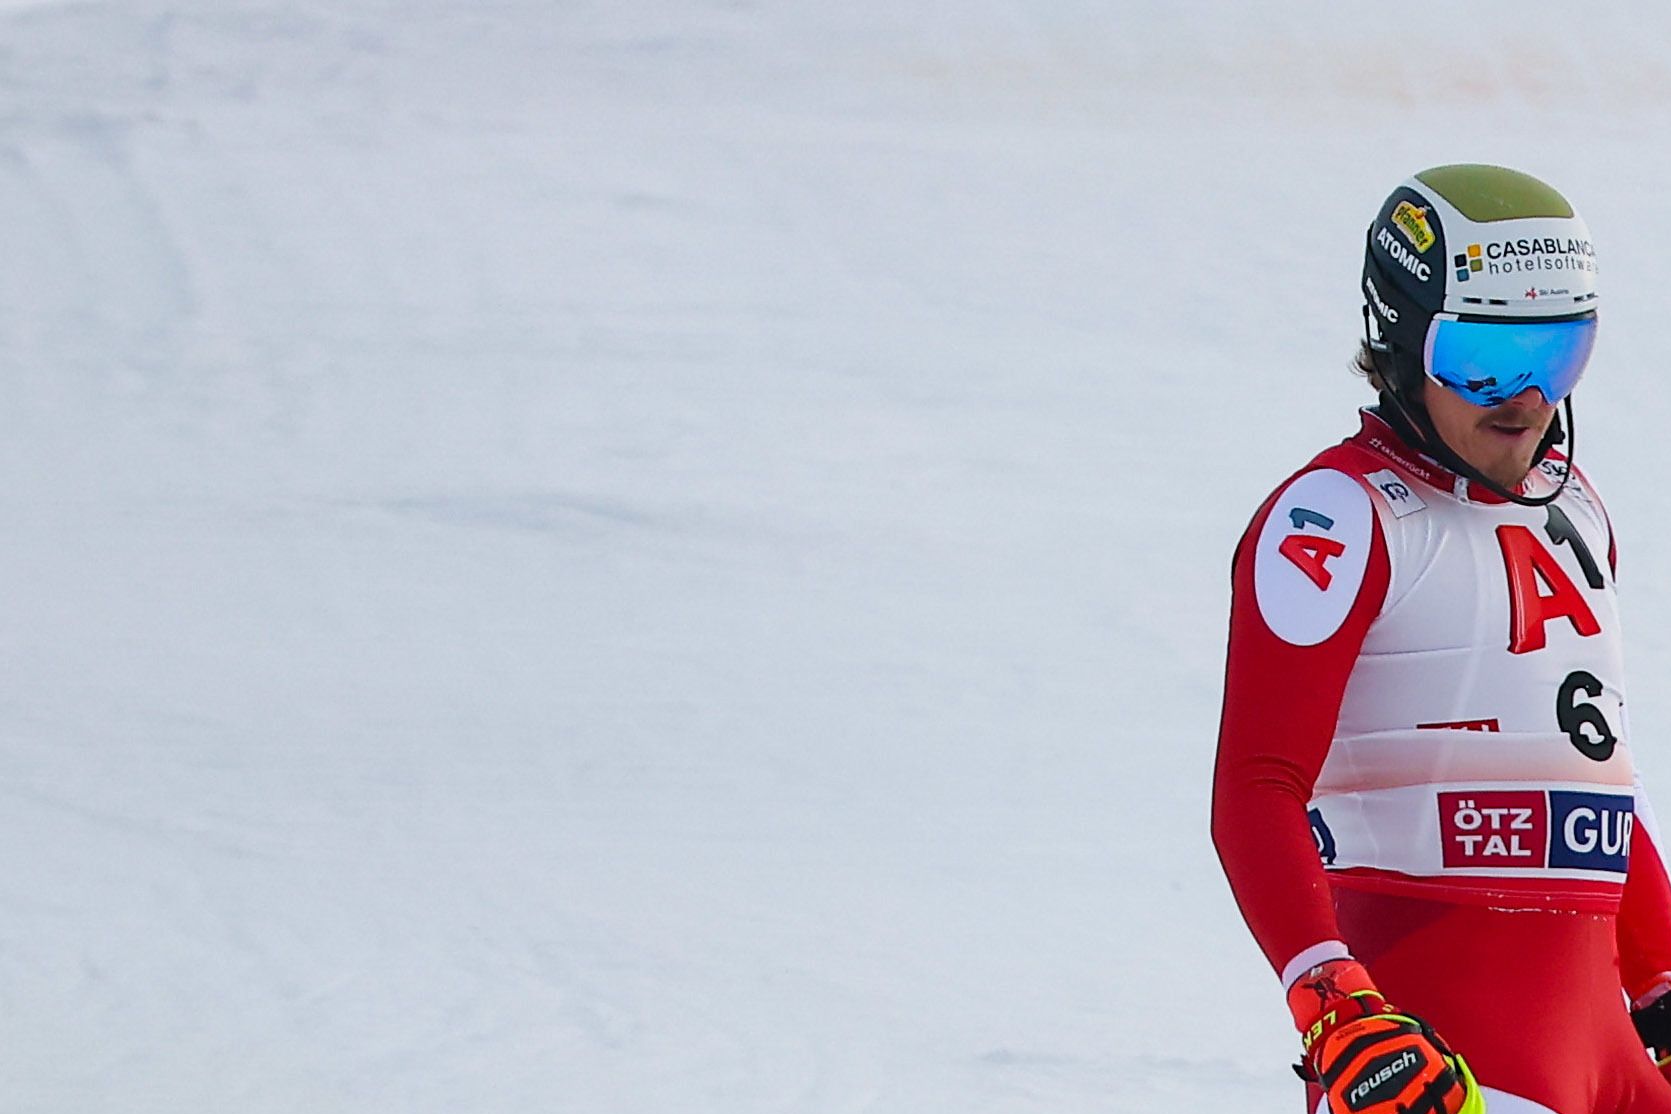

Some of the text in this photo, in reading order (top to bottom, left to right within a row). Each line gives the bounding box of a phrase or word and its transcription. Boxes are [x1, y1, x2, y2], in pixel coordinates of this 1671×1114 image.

[1377, 226, 1431, 282] ATOMIC
[1279, 507, 1346, 592] A1
[1495, 503, 1605, 655] A1
[1556, 670, 1617, 762] 6
[1454, 800, 1533, 830] ÖTZ
[1455, 835, 1532, 856] TAL
[1350, 1051, 1417, 1104] reusch
